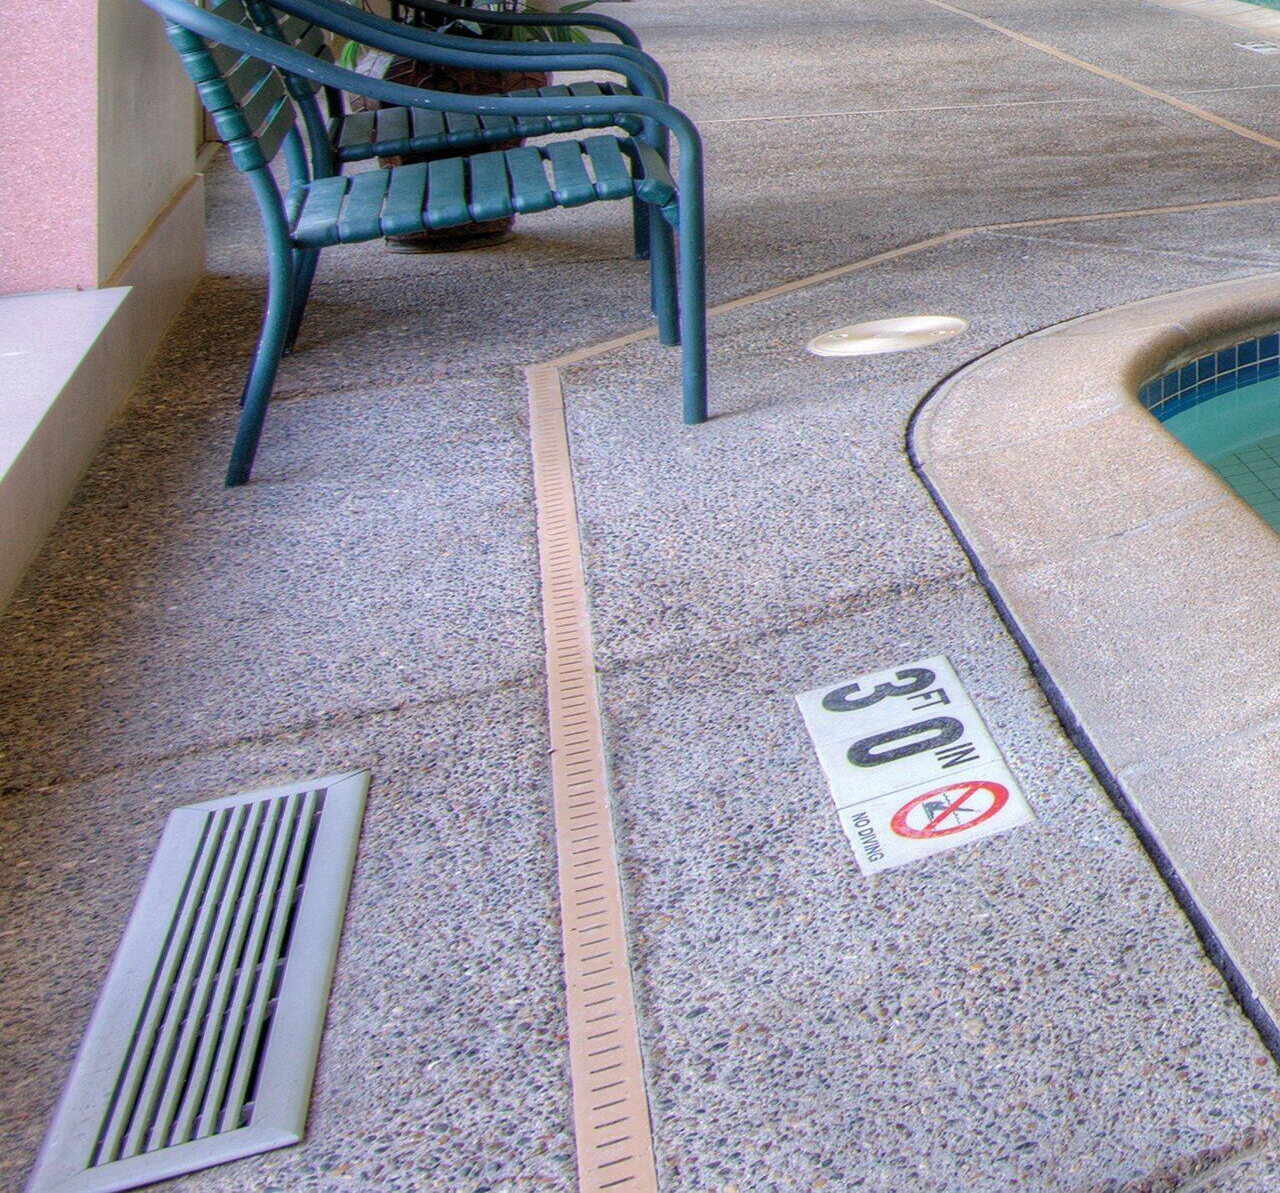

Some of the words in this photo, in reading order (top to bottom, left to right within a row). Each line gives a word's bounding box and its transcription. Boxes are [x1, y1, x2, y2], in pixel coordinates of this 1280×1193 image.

[821, 667, 936, 713] 3
[907, 688, 951, 711] FT
[846, 716, 965, 768] 0
[935, 742, 980, 770] IN
[851, 811, 871, 829] NO
[857, 824, 885, 863] DIVING
